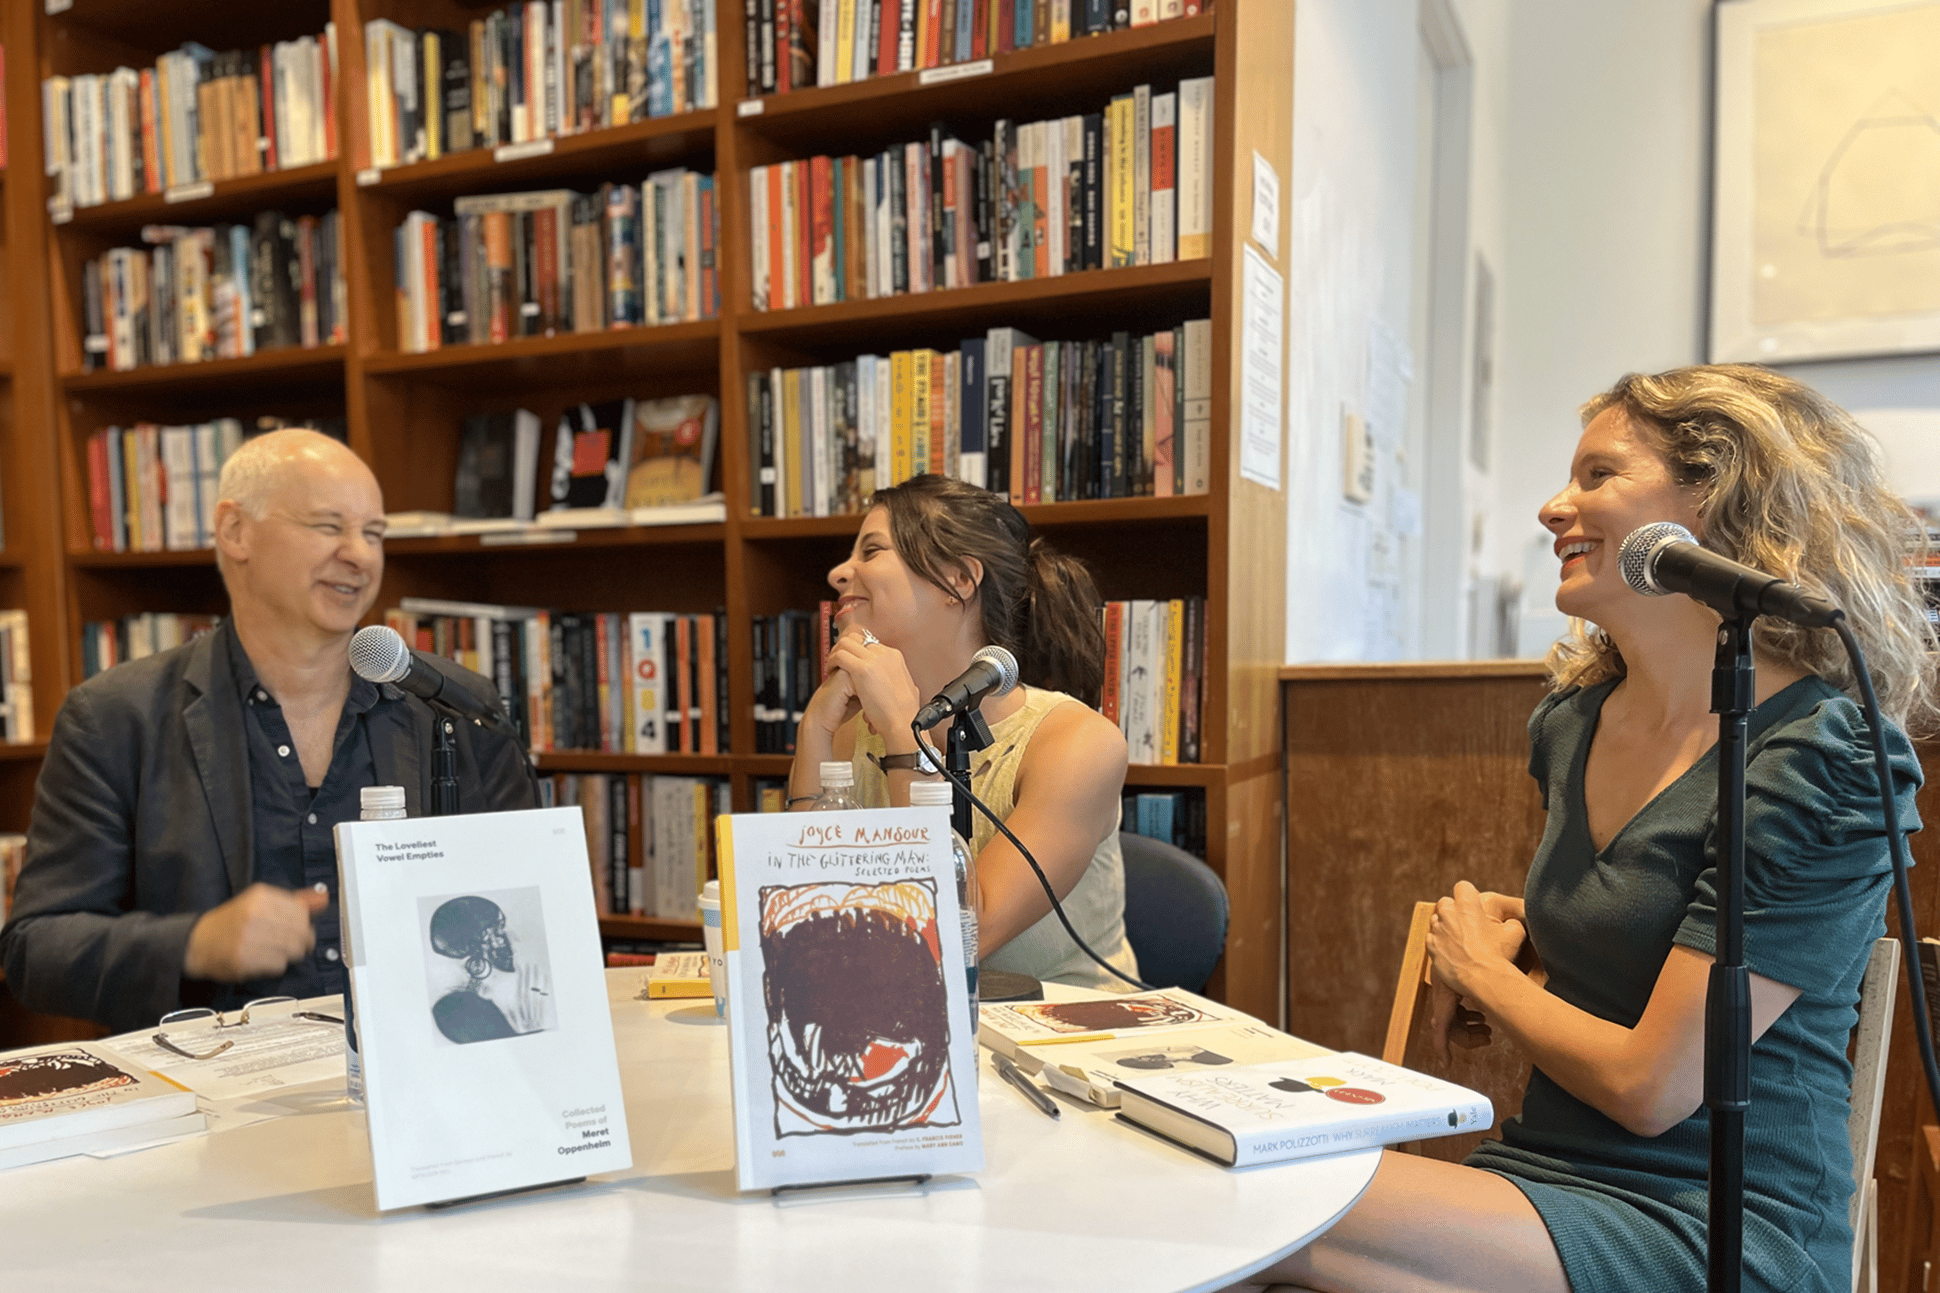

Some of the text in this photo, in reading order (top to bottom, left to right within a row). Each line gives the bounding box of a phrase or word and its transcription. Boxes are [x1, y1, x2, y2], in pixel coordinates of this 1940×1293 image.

[855, 826, 931, 844] MANSOUR
[375, 840, 437, 852] The Loveliest
[376, 851, 444, 862] Vowel Empties
[787, 852, 816, 868] THE
[820, 851, 890, 869] GLITTERING
[855, 865, 931, 876] SELECTED POEMS
[562, 1104, 606, 1118] Collected
[565, 1115, 607, 1130] Poems of
[582, 1127, 609, 1139] Meret
[557, 1140, 611, 1155] Oppenheim
[1252, 1142, 1279, 1155] MARK
